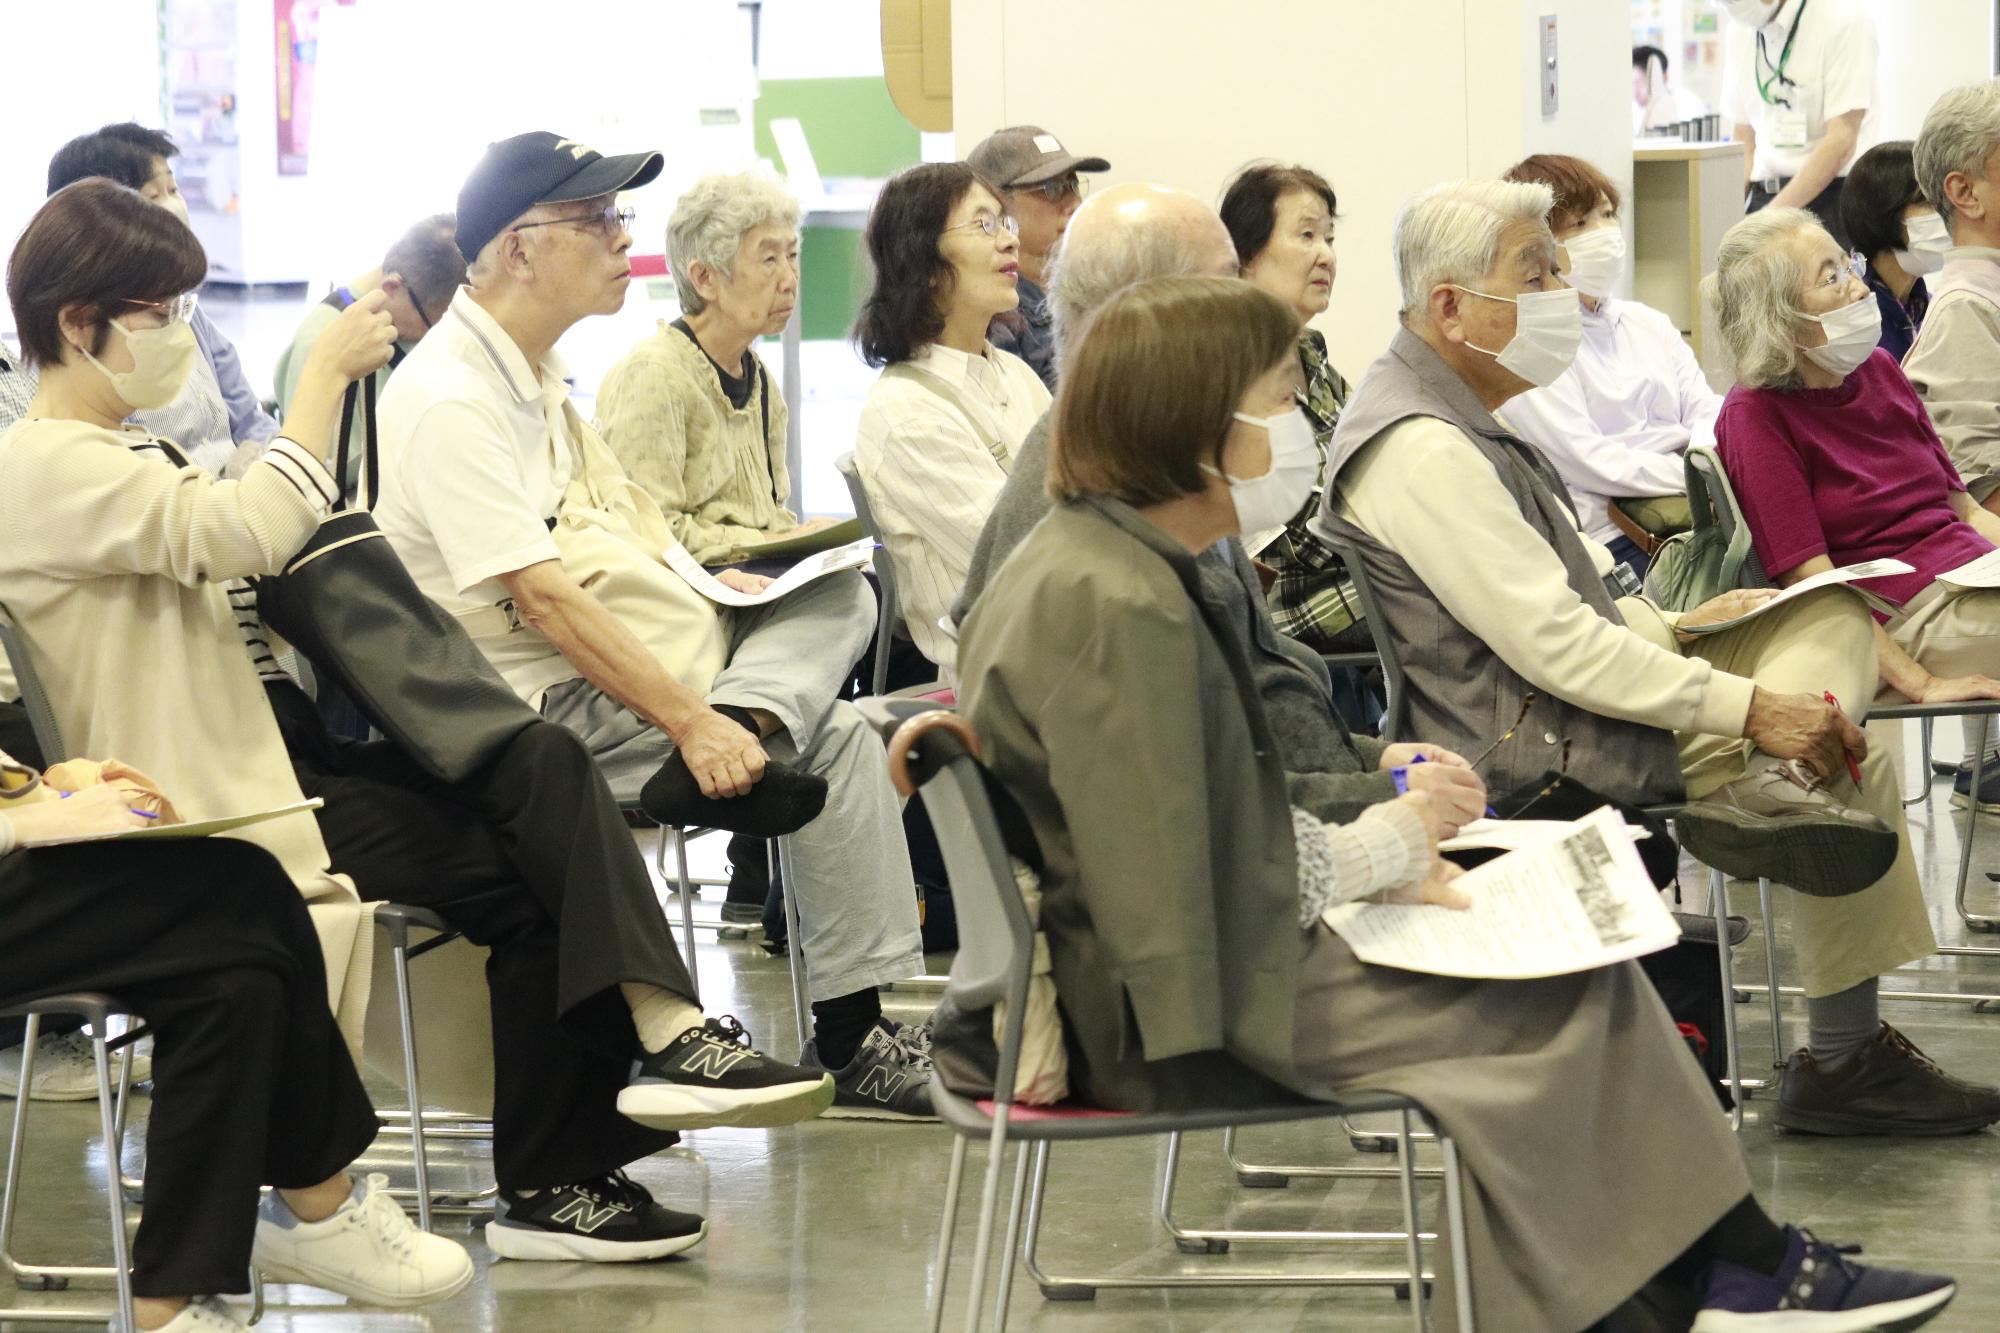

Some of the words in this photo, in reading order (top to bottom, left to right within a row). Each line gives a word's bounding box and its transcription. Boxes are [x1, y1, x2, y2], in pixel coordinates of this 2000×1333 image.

[680, 1043, 748, 1080] N
[856, 1064, 907, 1102] N
[550, 1196, 621, 1233] N
